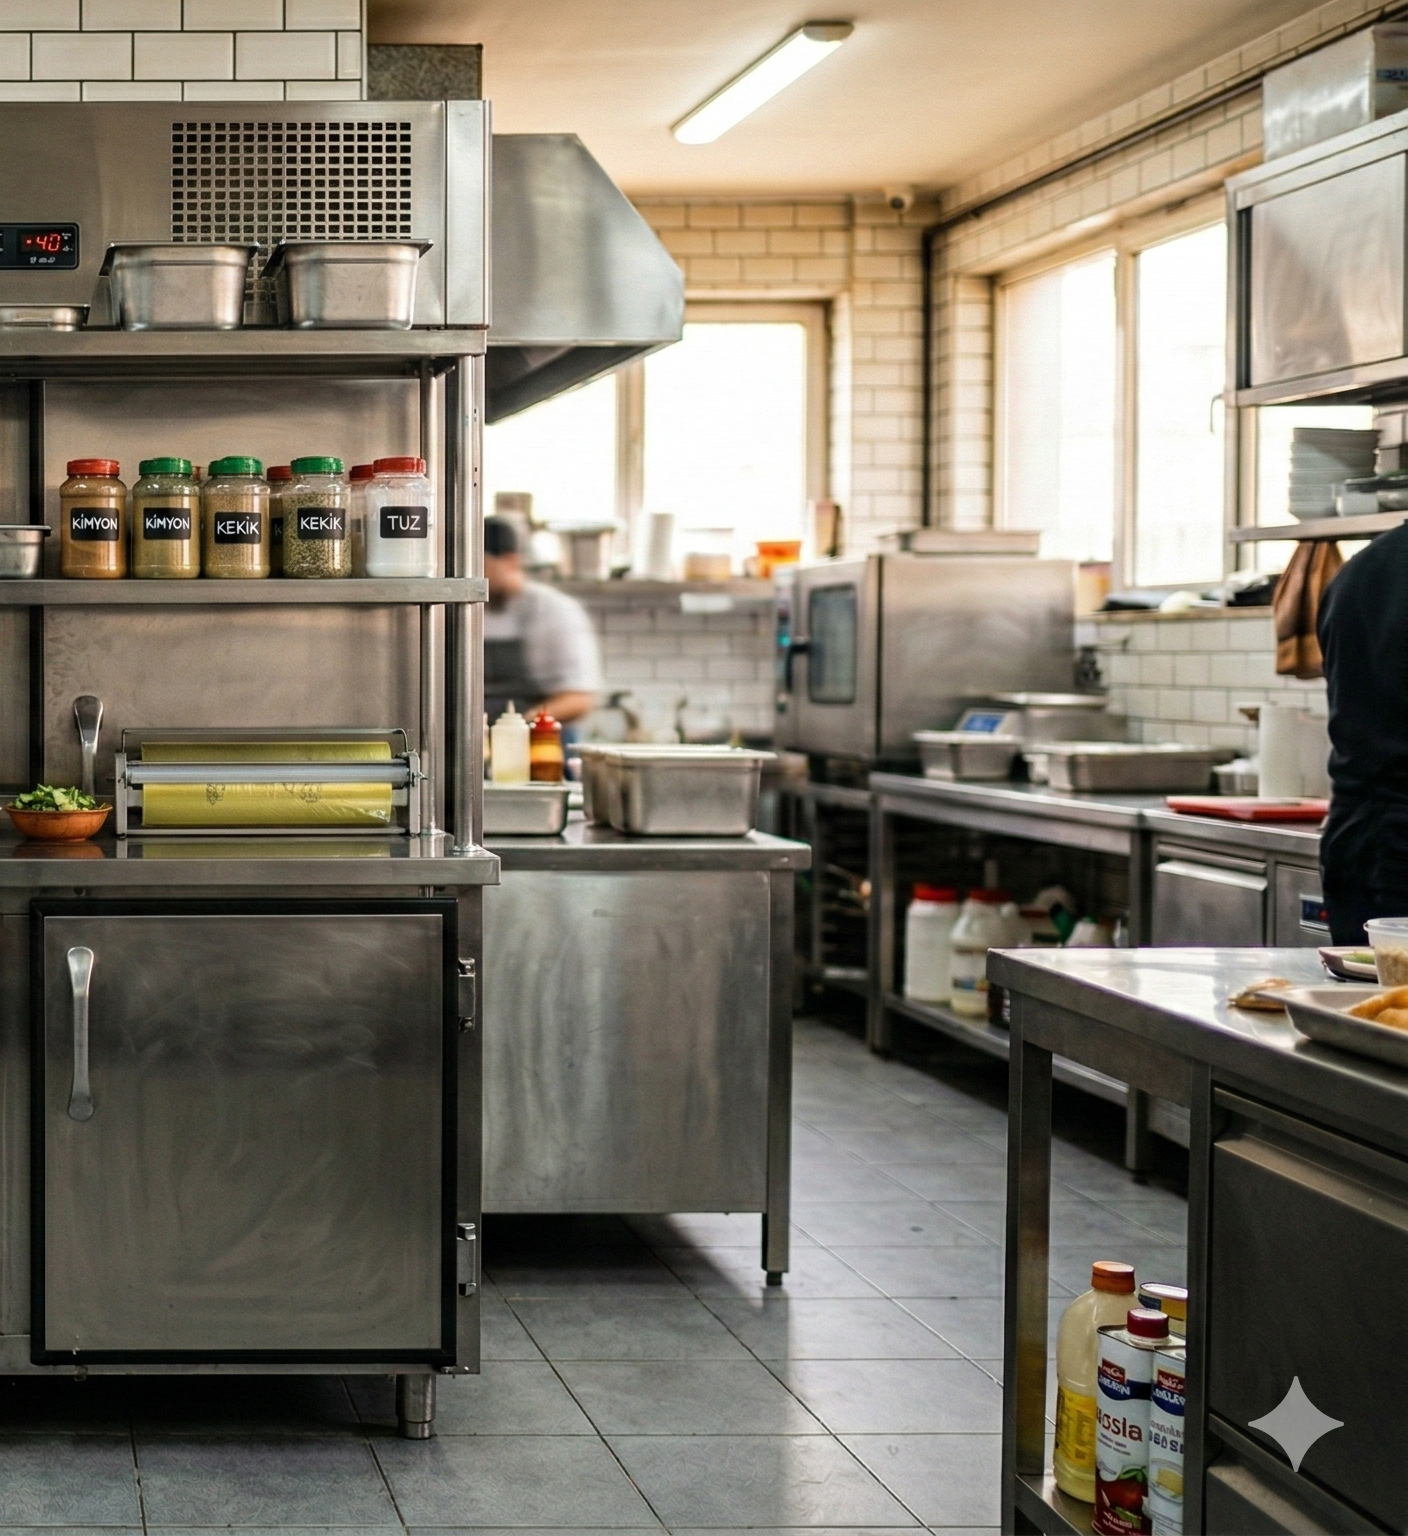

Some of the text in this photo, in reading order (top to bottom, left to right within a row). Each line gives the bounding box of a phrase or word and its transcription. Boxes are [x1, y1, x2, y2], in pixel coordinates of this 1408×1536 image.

[217, 515, 260, 535] KEKİK
[300, 513, 343, 530] KEKİK
[386, 515, 421, 531] TUZ
